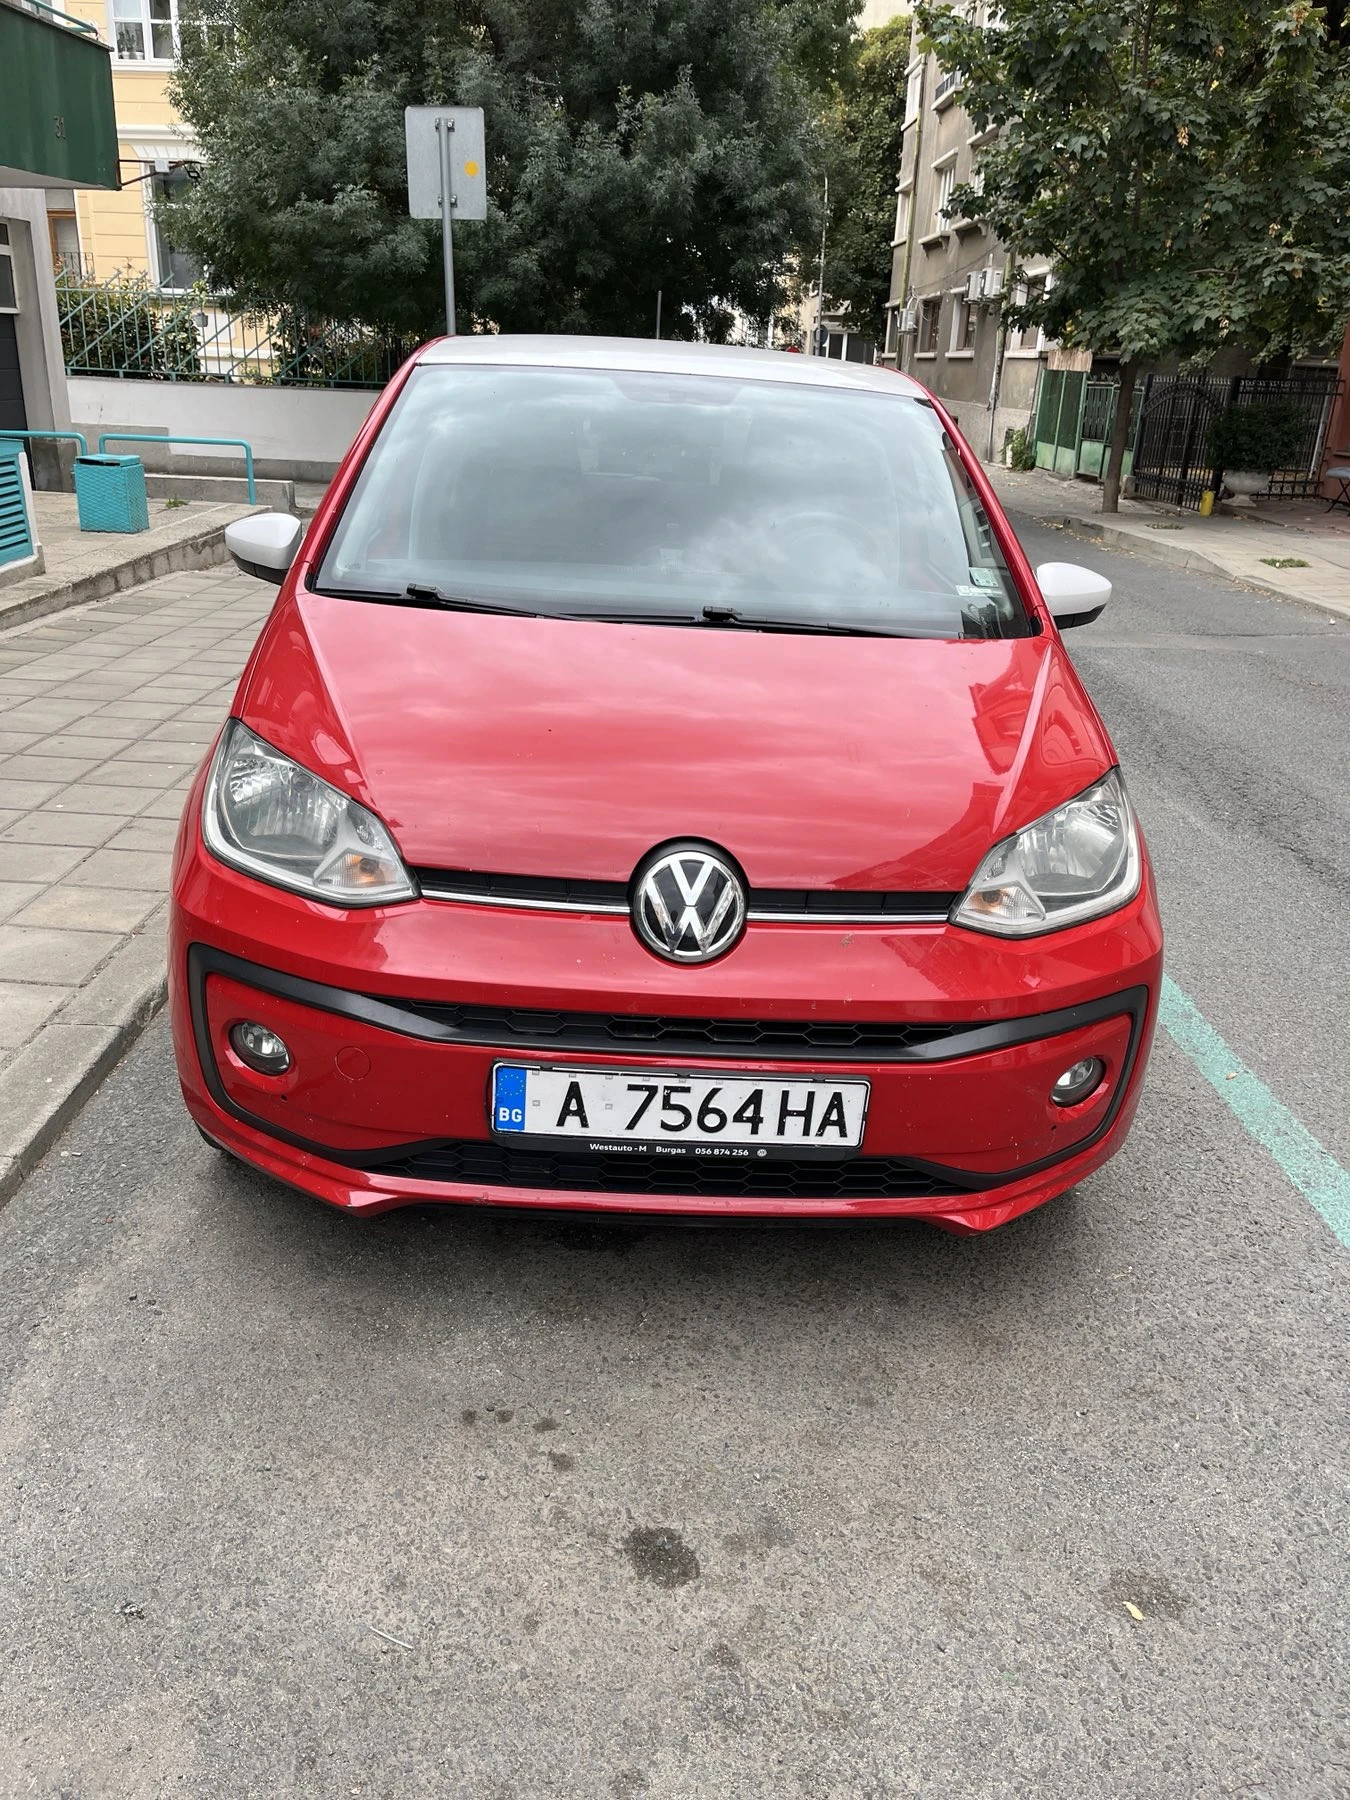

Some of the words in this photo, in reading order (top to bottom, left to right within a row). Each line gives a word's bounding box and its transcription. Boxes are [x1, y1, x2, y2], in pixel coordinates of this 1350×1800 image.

[556, 1081, 590, 1128] A
[499, 1107, 523, 1122] BG
[655, 1146, 686, 1154] Burgas
[694, 1147, 712, 1155] 056
[731, 1148, 749, 1156] 256
